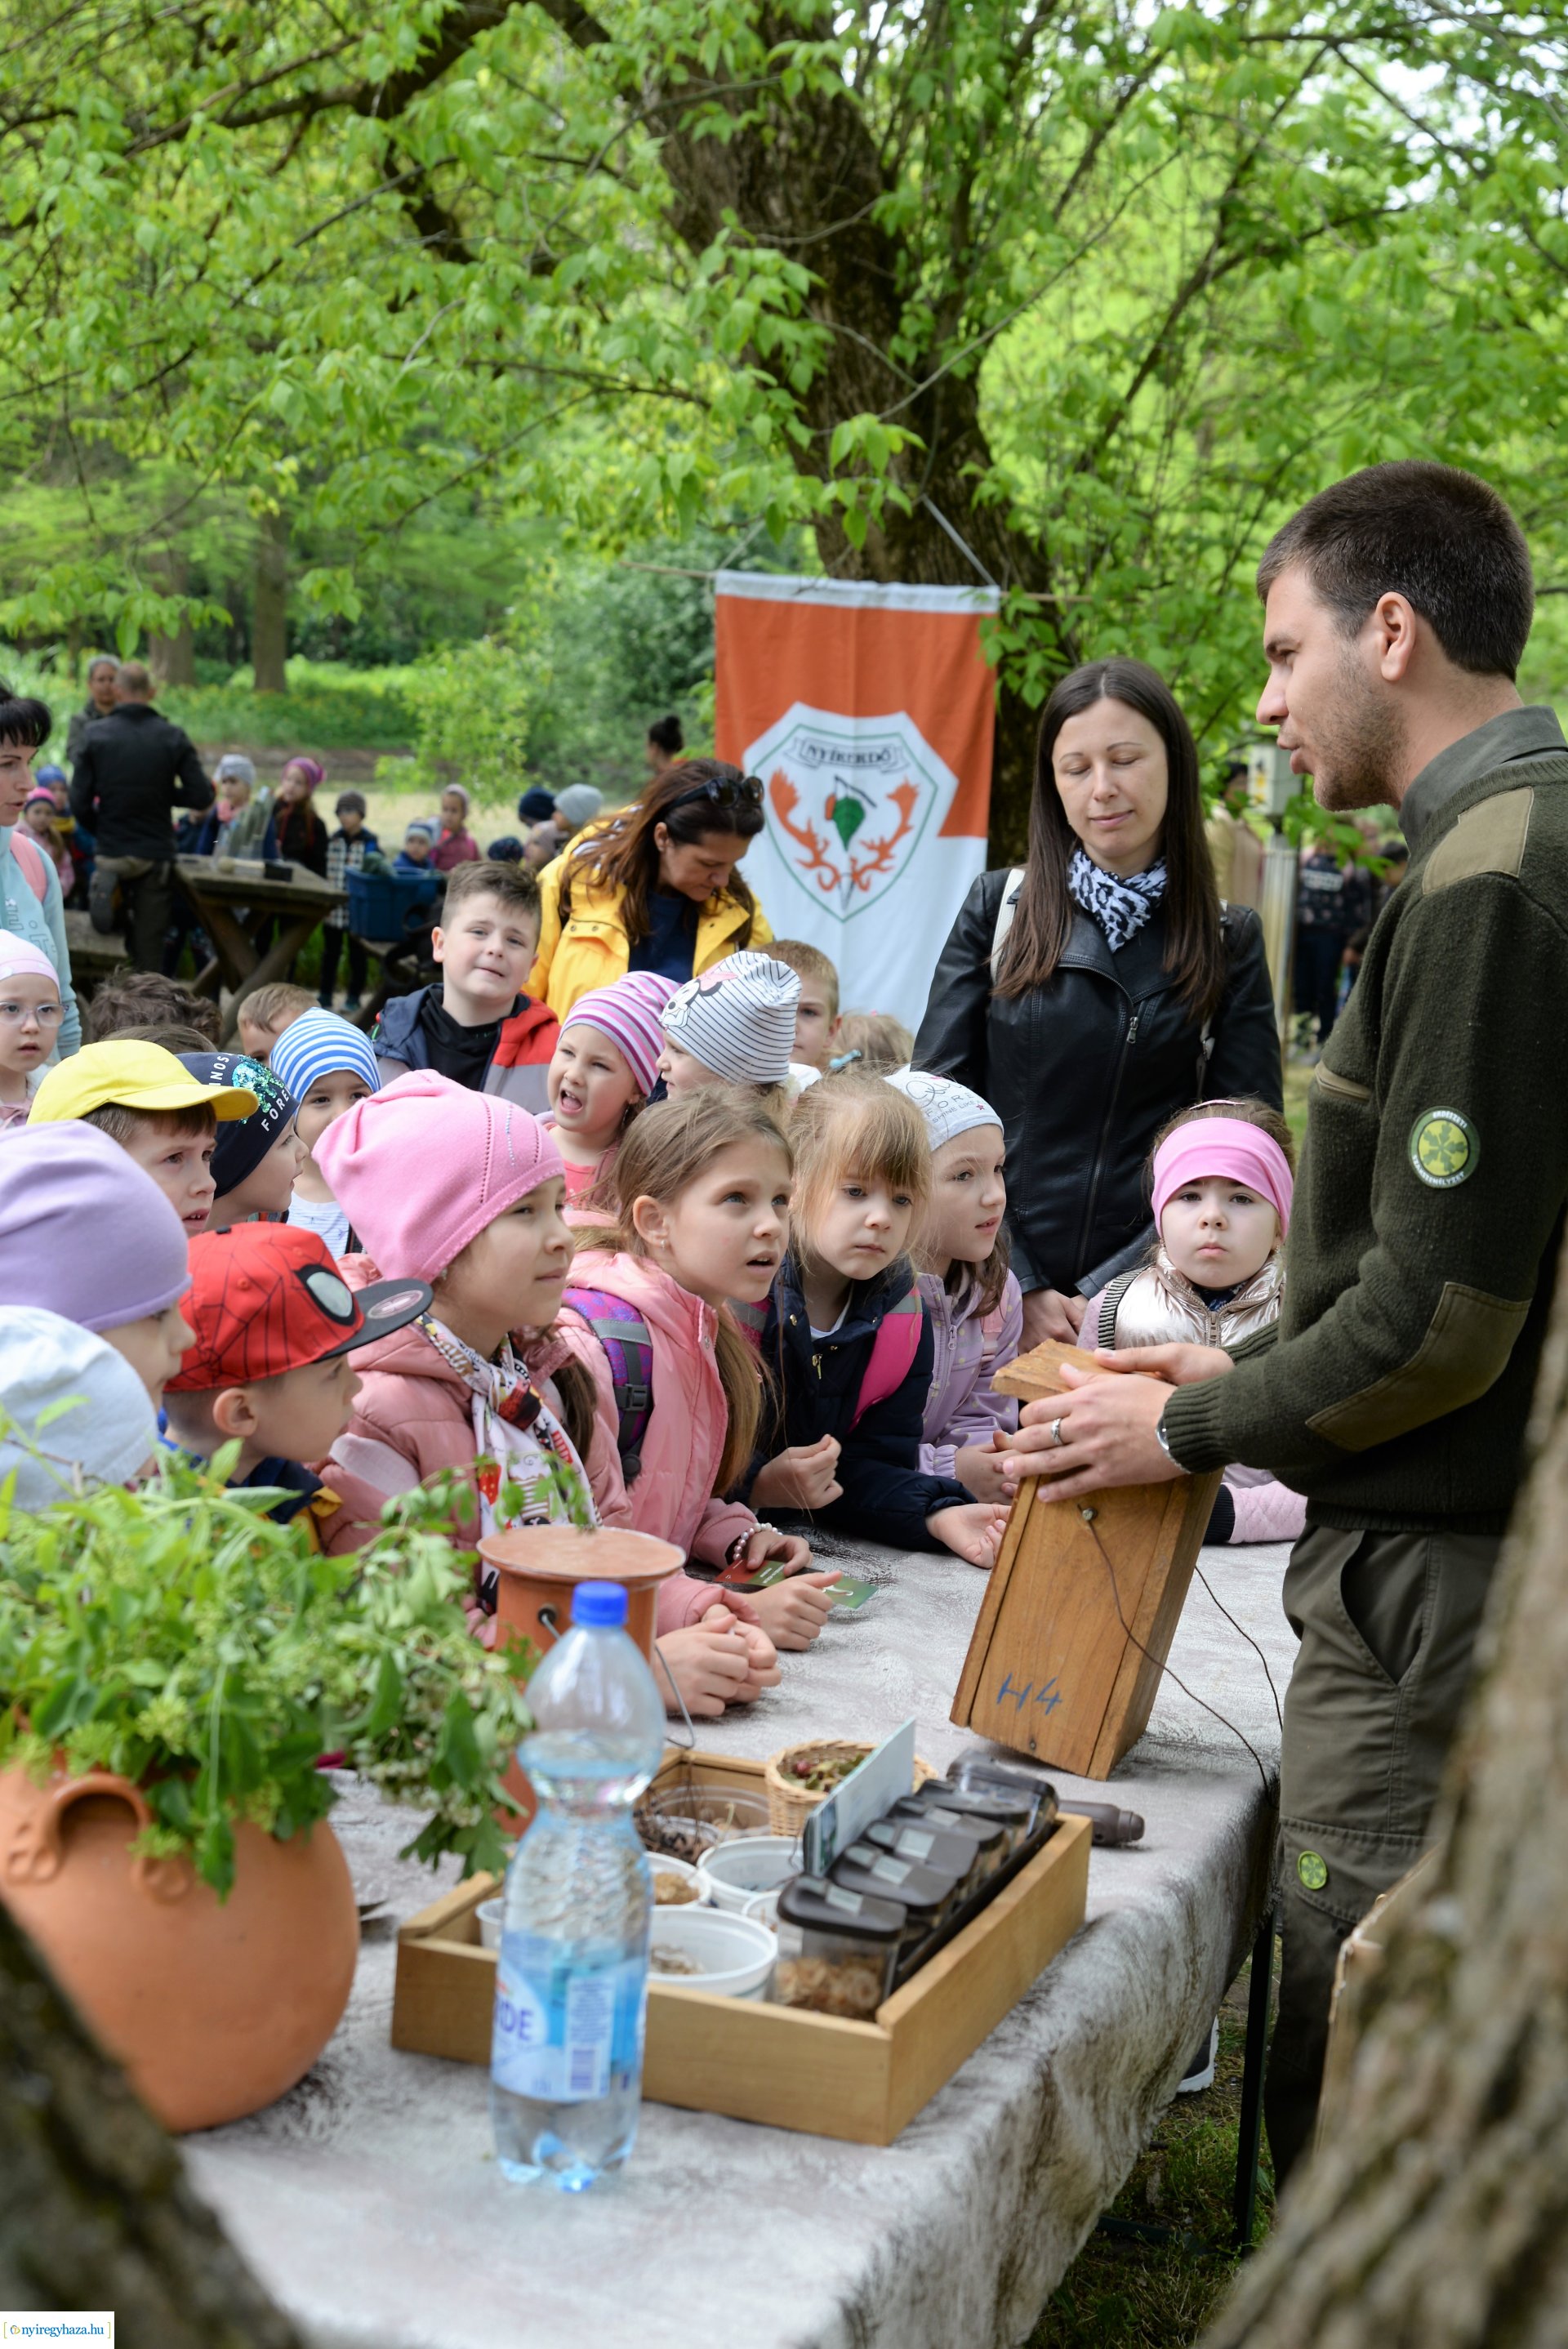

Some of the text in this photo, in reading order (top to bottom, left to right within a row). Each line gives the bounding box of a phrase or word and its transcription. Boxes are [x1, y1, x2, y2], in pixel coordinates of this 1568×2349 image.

[807, 744, 892, 764] NYÍRERDŐ
[209, 1053, 232, 1086] INOS
[261, 1090, 291, 1131] FORE
[924, 1092, 974, 1117] FORE
[932, 1106, 958, 1123] SHINE
[959, 1100, 975, 1109] LIKE
[996, 1672, 1062, 1716] H4
